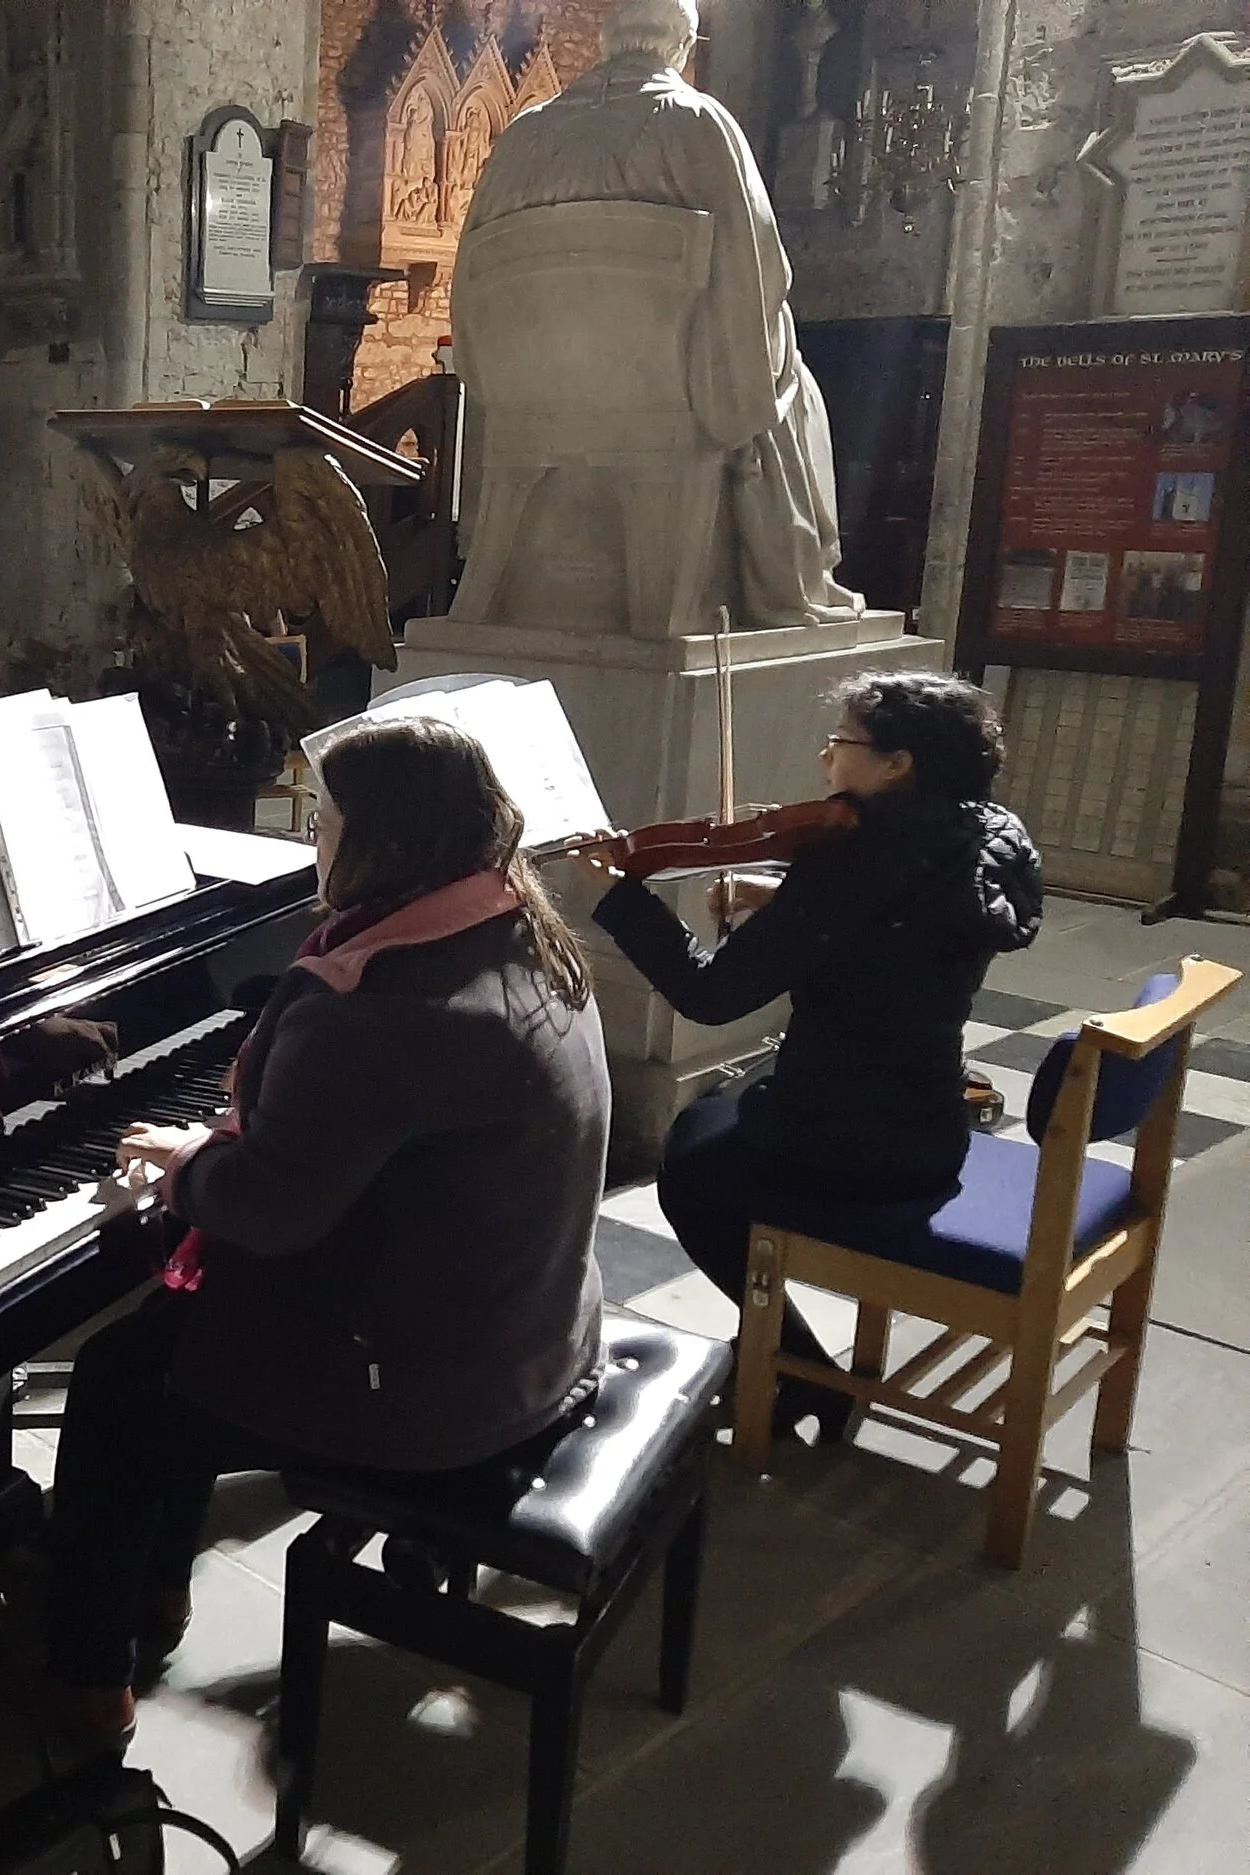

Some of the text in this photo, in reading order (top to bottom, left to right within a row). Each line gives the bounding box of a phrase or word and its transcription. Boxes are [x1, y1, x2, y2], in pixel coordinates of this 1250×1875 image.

[1018, 356, 1050, 368] THE
[1057, 354, 1106, 368] BELLS
[1112, 354, 1134, 366] OF
[1166, 350, 1244, 364] MARY'S
